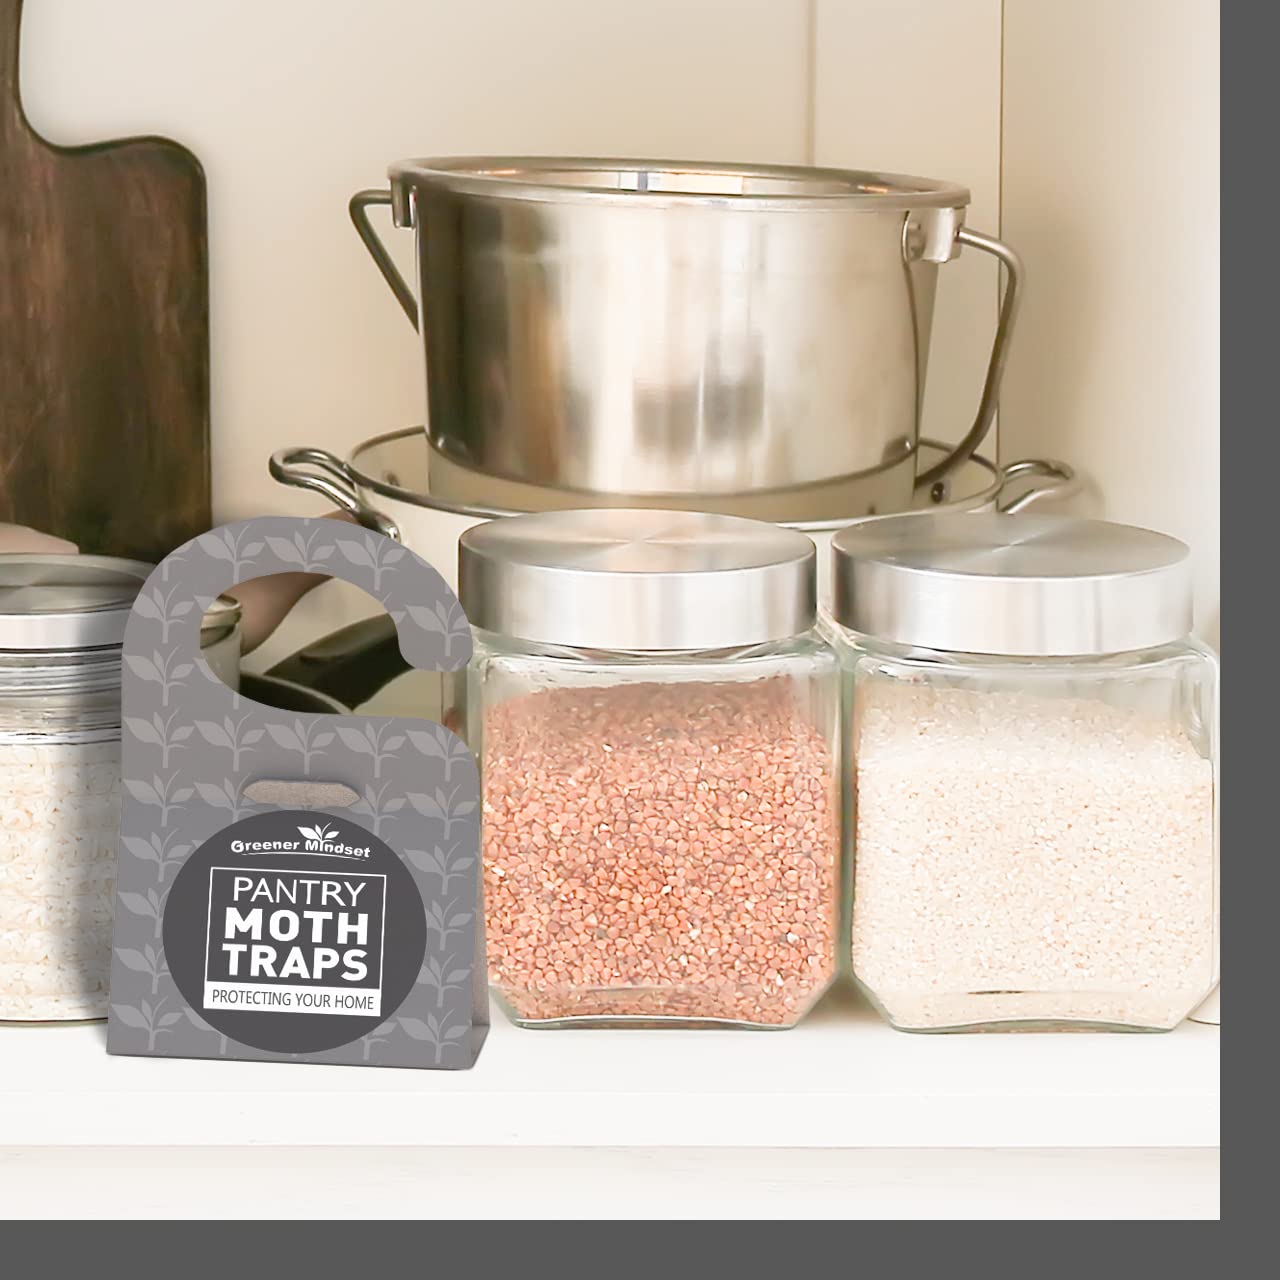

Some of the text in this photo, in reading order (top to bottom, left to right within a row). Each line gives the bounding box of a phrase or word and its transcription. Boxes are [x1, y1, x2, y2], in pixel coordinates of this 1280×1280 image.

[231, 840, 370, 858] Greener Mindset
[233, 877, 366, 906] PANTRY
[225, 907, 368, 945] MOTH
[222, 943, 368, 981] TRAPS
[212, 989, 374, 1009] PROTECTING YOUR HOME
